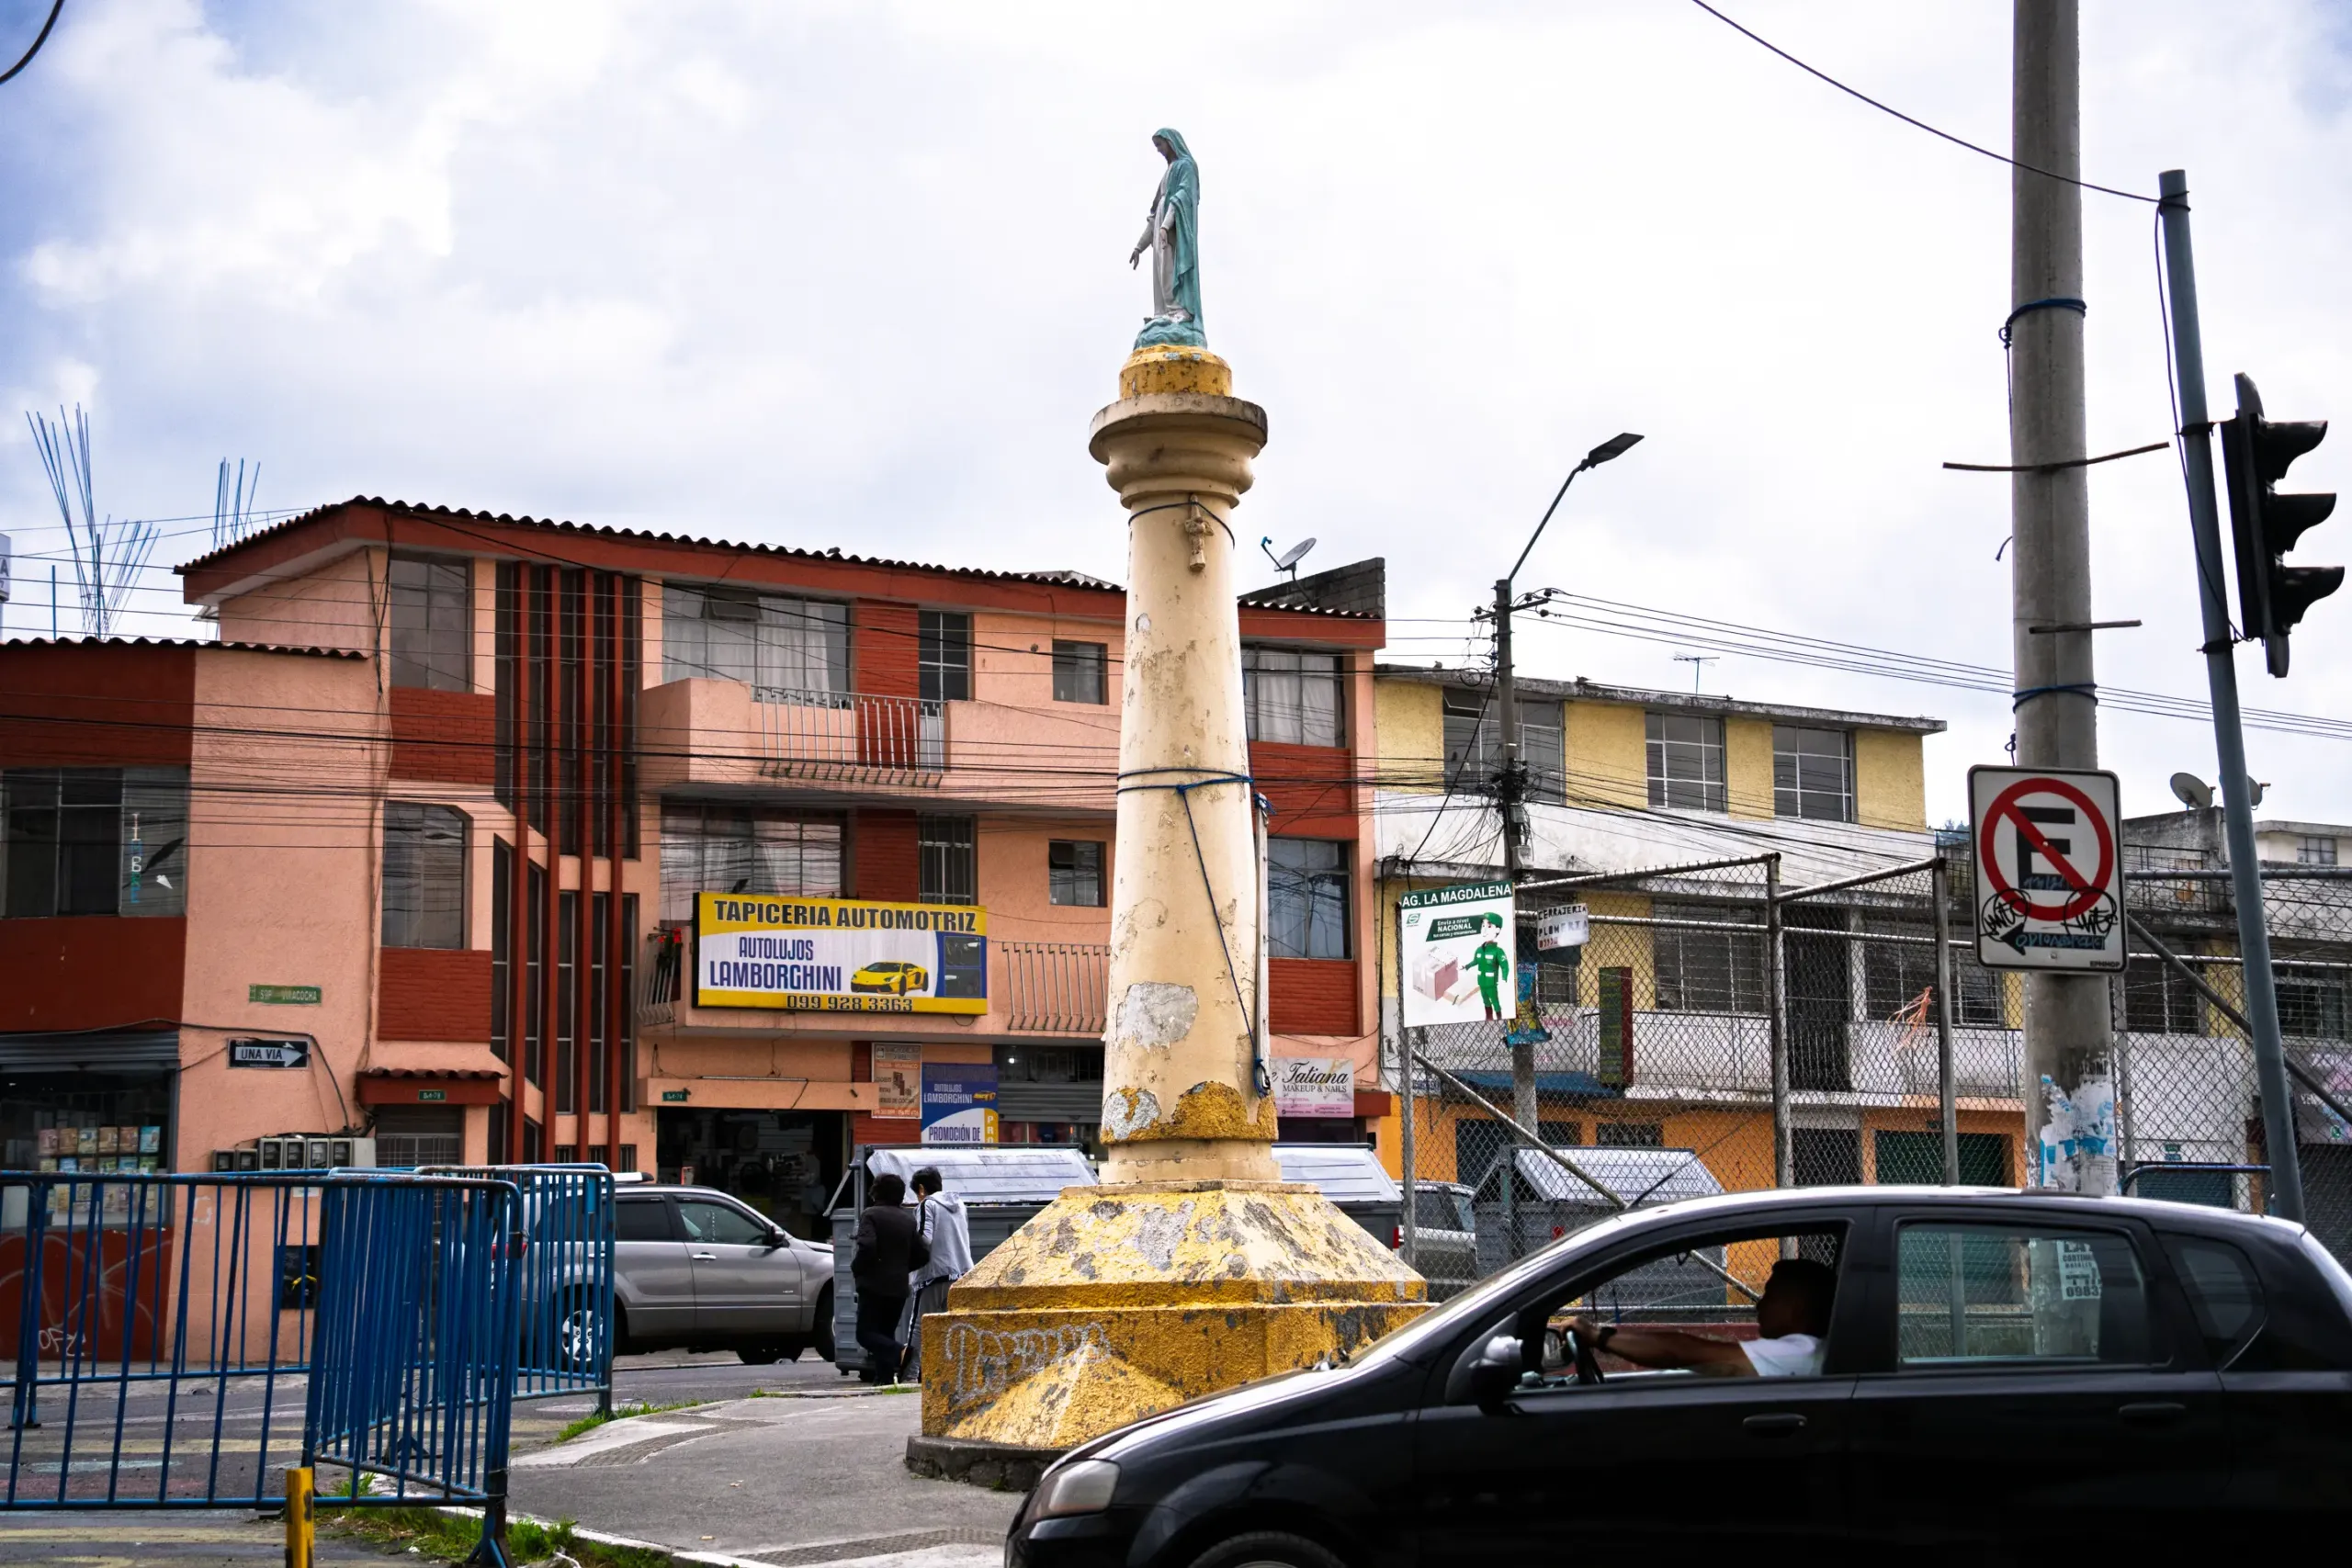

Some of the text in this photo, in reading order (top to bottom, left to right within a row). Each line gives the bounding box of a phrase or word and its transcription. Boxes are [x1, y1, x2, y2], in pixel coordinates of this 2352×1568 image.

[1402, 884, 1512, 908] AG. LA MAGDALENA
[714, 899, 977, 932] TAPICERIA AUTOMOTRIZ
[1538, 905, 1587, 921] CERRAJERIA
[1437, 923, 1473, 932] NACIONAL
[739, 936, 814, 961] AUTOLUJOS
[709, 961, 842, 991] LAMBORGHINI
[786, 995, 913, 1012] 099 928 3363
[241, 1049, 283, 1060] UNA VIA
[1282, 1061, 1349, 1084] Tatiana
[933, 1083, 963, 1093] AUTOLUJOS
[1283, 1085, 1347, 1093] MAKEUP & NAILS
[923, 1093, 973, 1104] LAMBORGHINI
[928, 1123, 981, 1141] PROMOCIÓN DE
